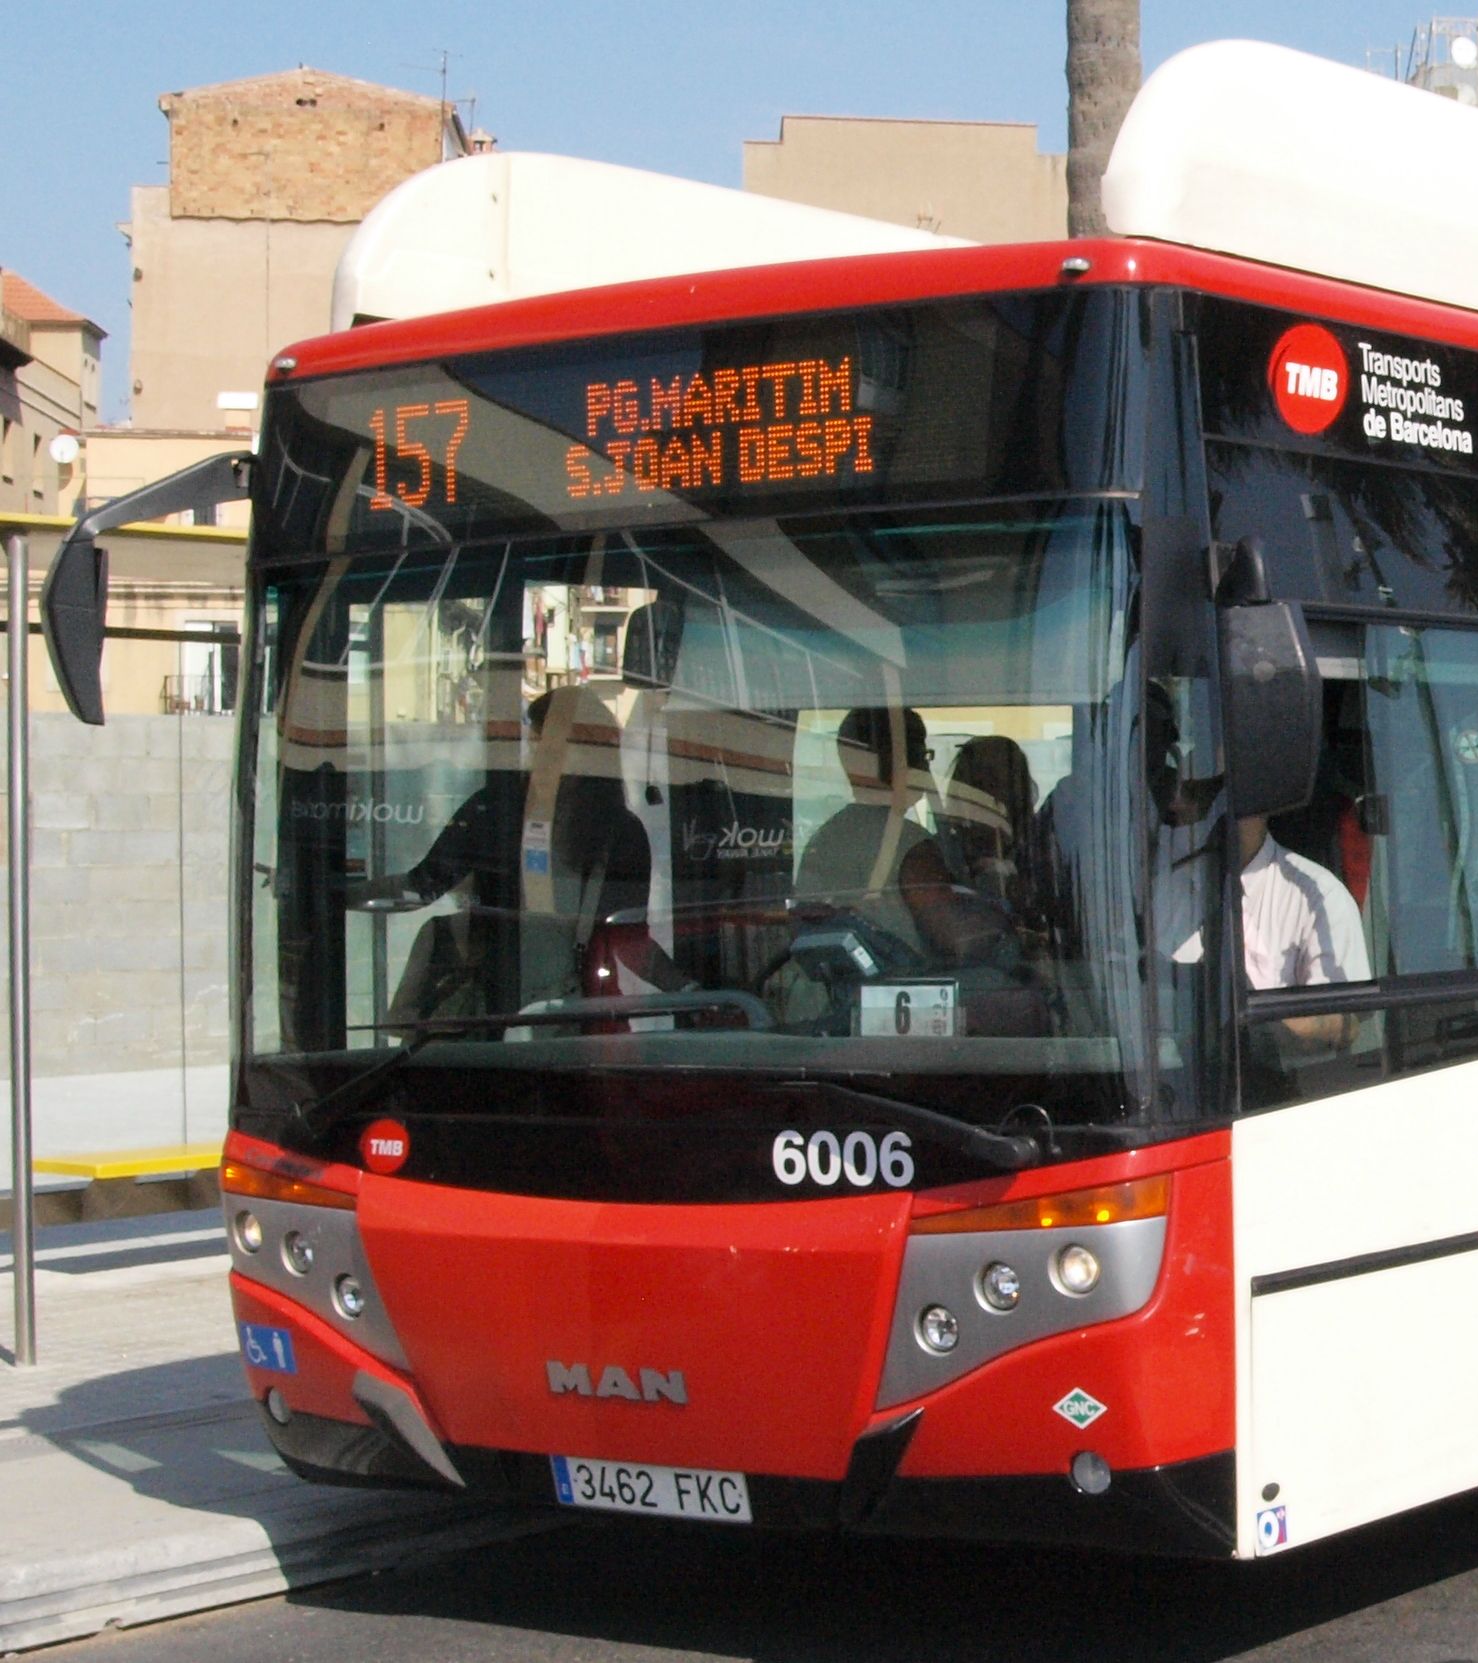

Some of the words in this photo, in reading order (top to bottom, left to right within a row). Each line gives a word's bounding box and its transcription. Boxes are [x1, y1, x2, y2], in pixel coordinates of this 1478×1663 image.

[1285, 362, 1338, 400] TMB
[1358, 342, 1441, 387] Transports
[1361, 374, 1464, 421] Metropolitans
[739, 416, 873, 483] DESPI
[1363, 408, 1387, 438] de
[1390, 412, 1473, 454] Barcelona
[369, 399, 469, 510] 157
[895, 991, 911, 1035] 6
[370, 1139, 403, 1156] TMB
[772, 1129, 915, 1187] 6006
[546, 1360, 688, 1405] MAN
[1063, 1400, 1096, 1416] GNC
[576, 1464, 658, 1507] 3462
[674, 1472, 740, 1514] FKC
